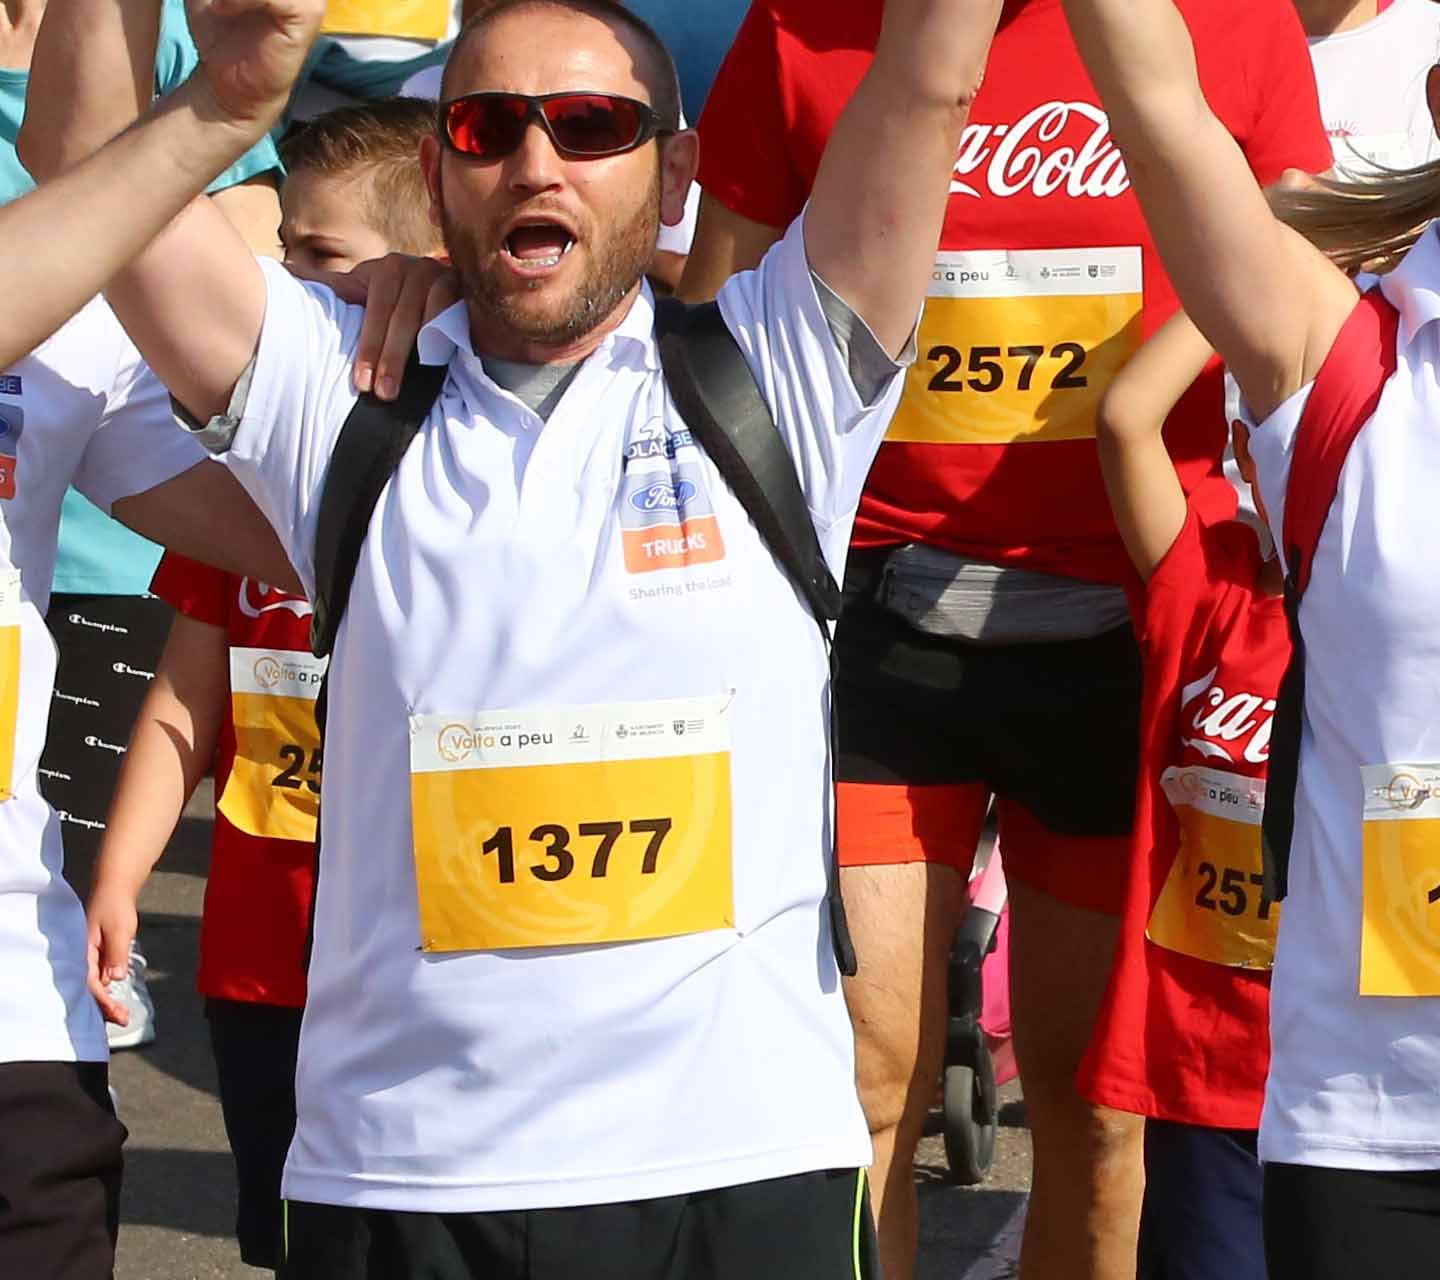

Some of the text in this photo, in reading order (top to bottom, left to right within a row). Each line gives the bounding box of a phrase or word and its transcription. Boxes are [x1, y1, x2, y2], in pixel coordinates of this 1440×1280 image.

[950, 100, 1131, 199] a-Cola
[960, 270, 990, 285] peu
[927, 342, 1089, 392] 2572
[643, 532, 707, 558] TRUCKS
[629, 582, 683, 602] Sharing
[68, 613, 129, 634] Champion
[112, 660, 156, 681] Champ
[263, 665, 297, 682] Volta
[53, 688, 100, 708] hampion
[84, 734, 128, 754] Champ
[452, 731, 554, 750] Volta a peu
[480, 818, 673, 884] 1377
